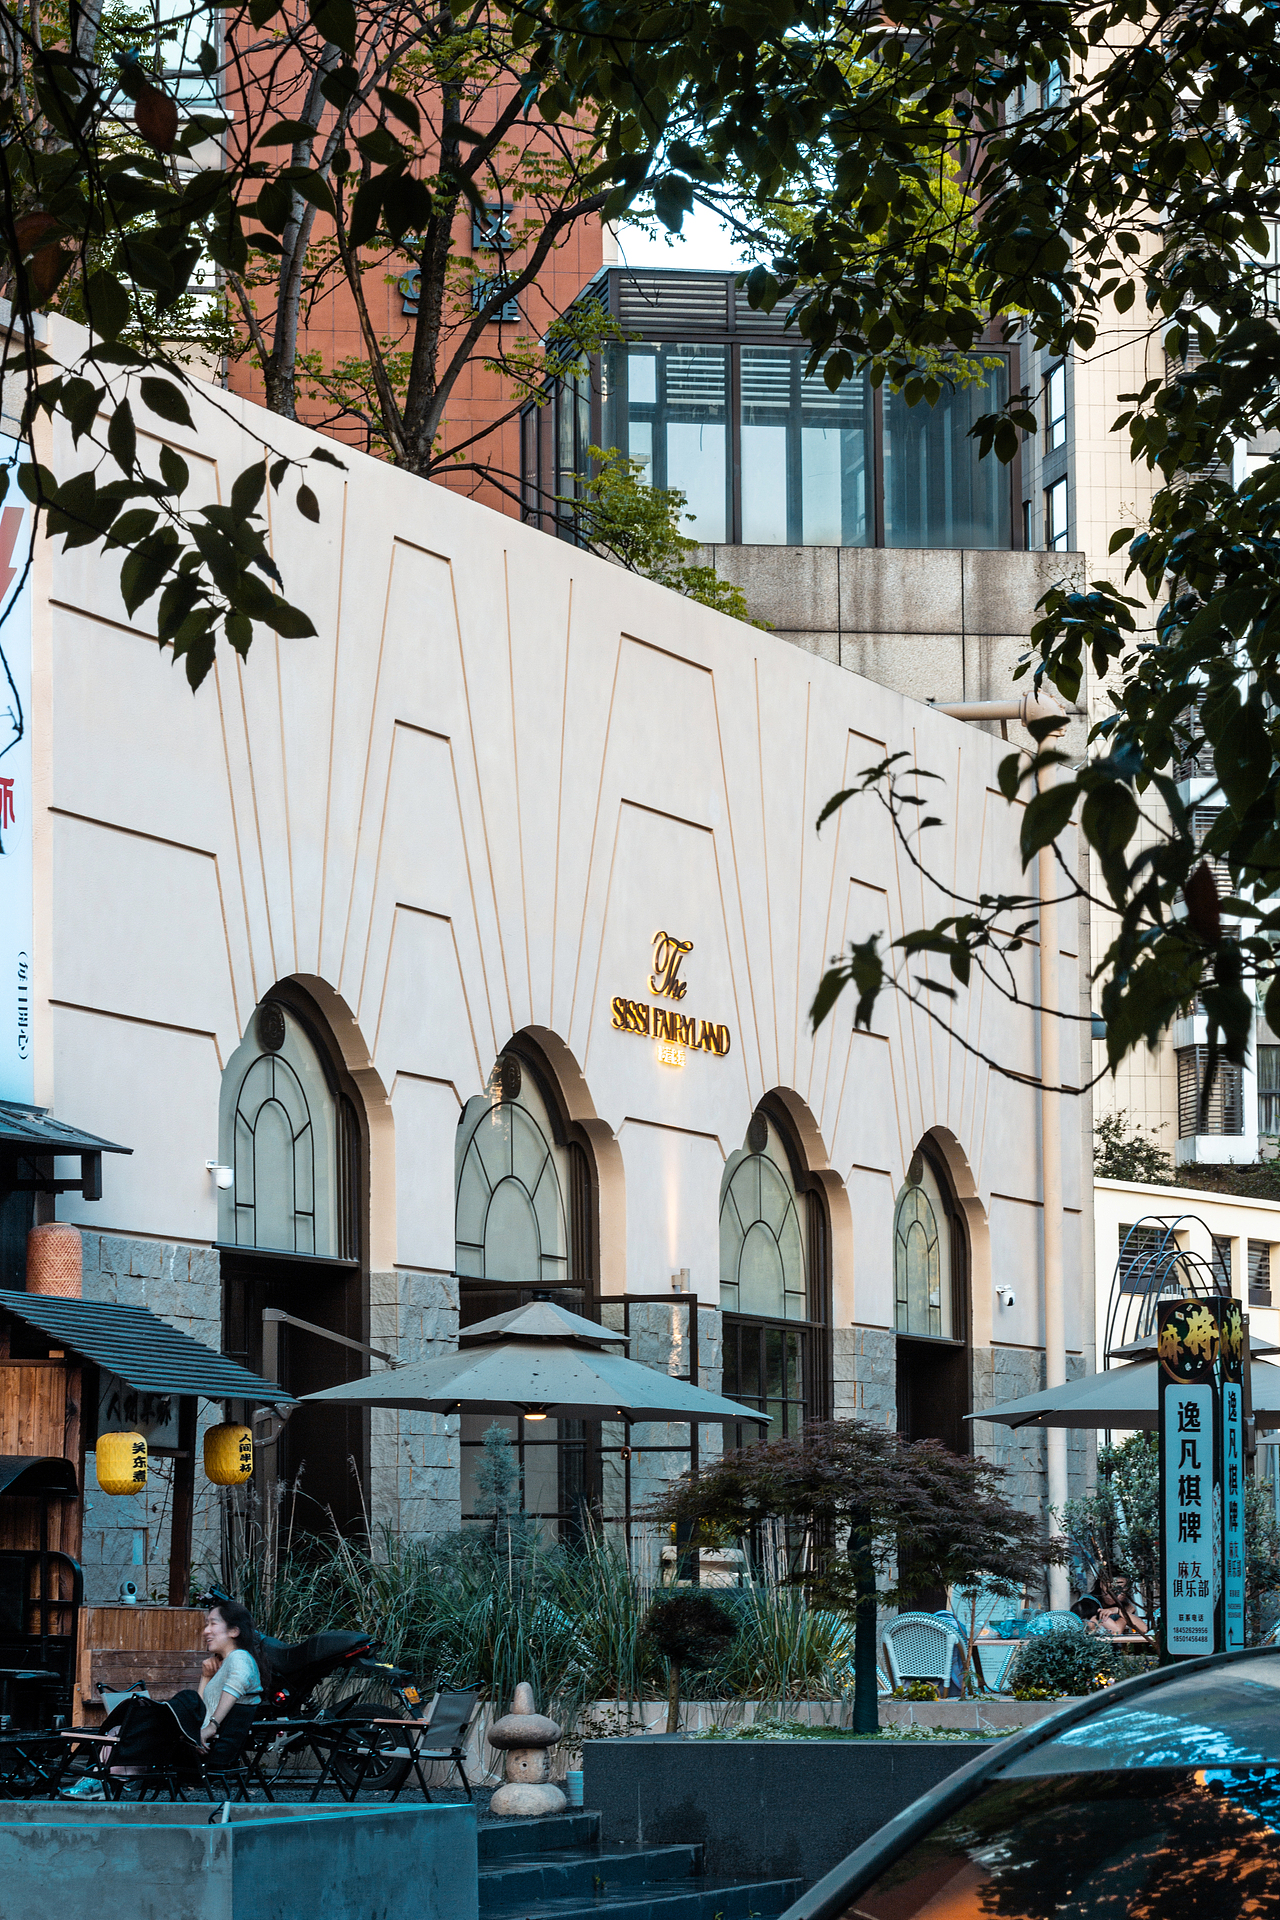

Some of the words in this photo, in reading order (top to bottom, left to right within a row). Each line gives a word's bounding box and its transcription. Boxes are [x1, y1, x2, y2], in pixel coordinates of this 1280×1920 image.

[648, 930, 694, 1000] The
[651, 1007, 731, 1055] FAIRYLAND
[132, 1442, 146, 1482] 关东煮
[1177, 1401, 1202, 1544] 逸凡棋牌
[1173, 1579, 1209, 1598] 俱乐部
[1178, 1561, 1202, 1579] 麻友
